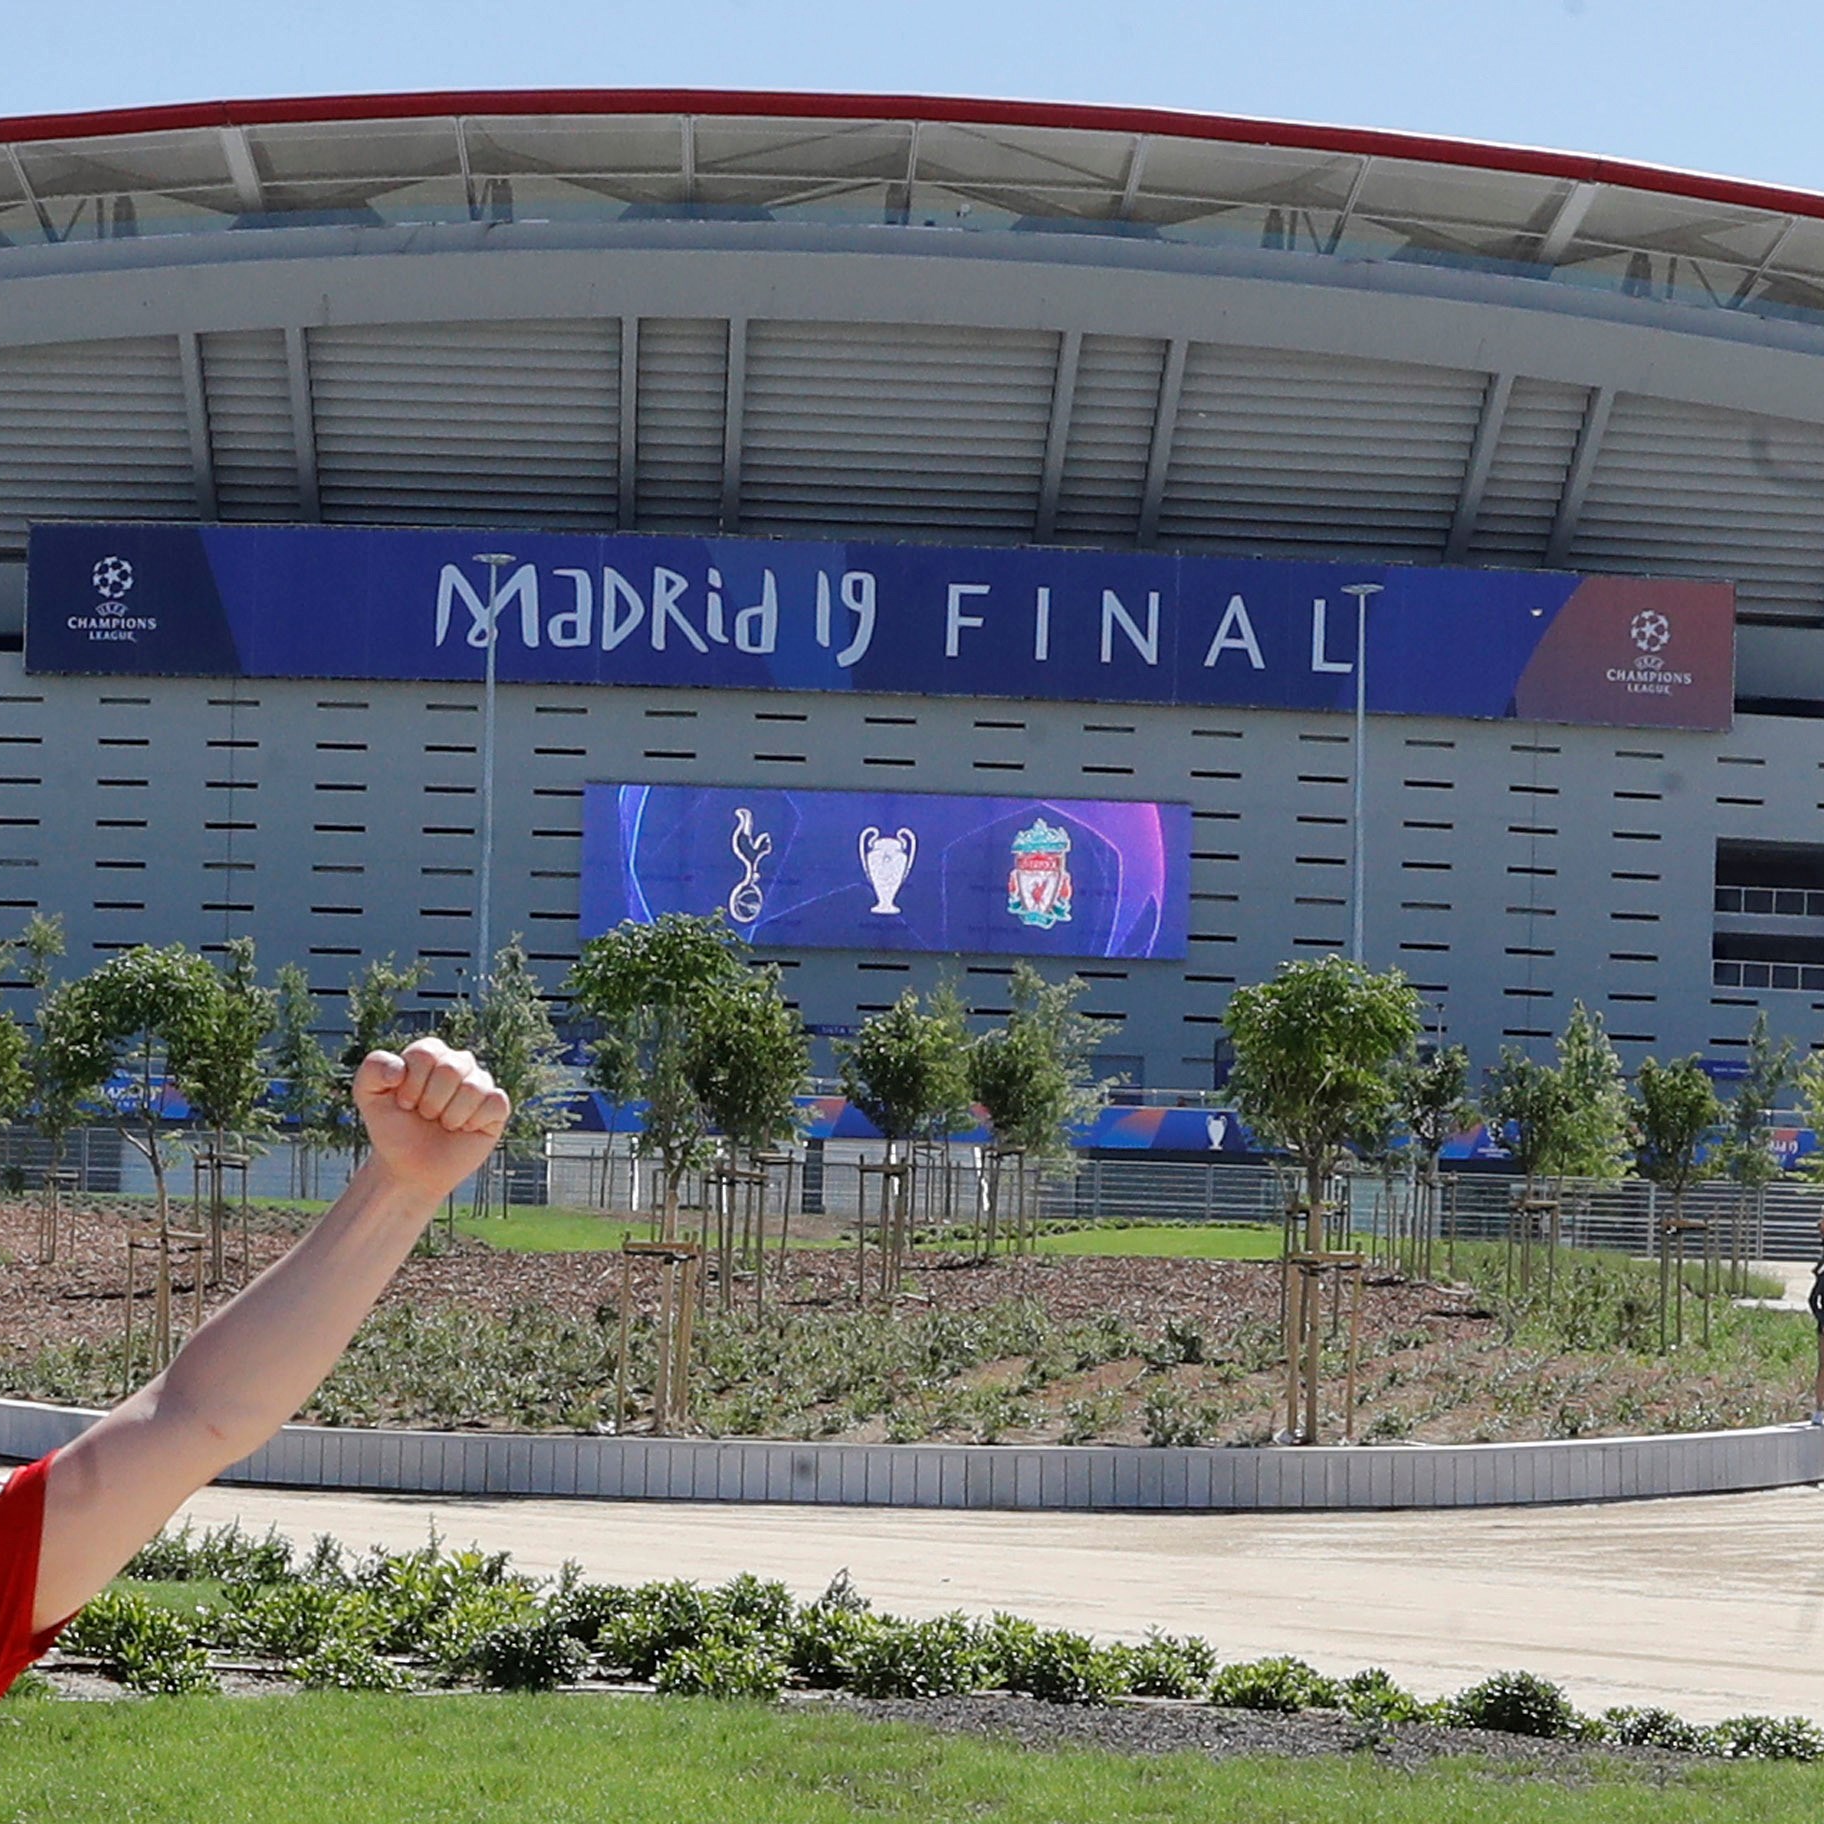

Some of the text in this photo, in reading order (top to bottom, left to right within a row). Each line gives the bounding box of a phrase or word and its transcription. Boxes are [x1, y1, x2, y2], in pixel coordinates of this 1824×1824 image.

[67, 616, 157, 630] CHAMPIONS
[815, 569, 876, 668] 19
[945, 583, 1355, 673] FINAL
[89, 630, 137, 643] LEAGUE
[1606, 668, 1693, 685] CHAMPIONS
[1627, 683, 1673, 696] LEAGUE
